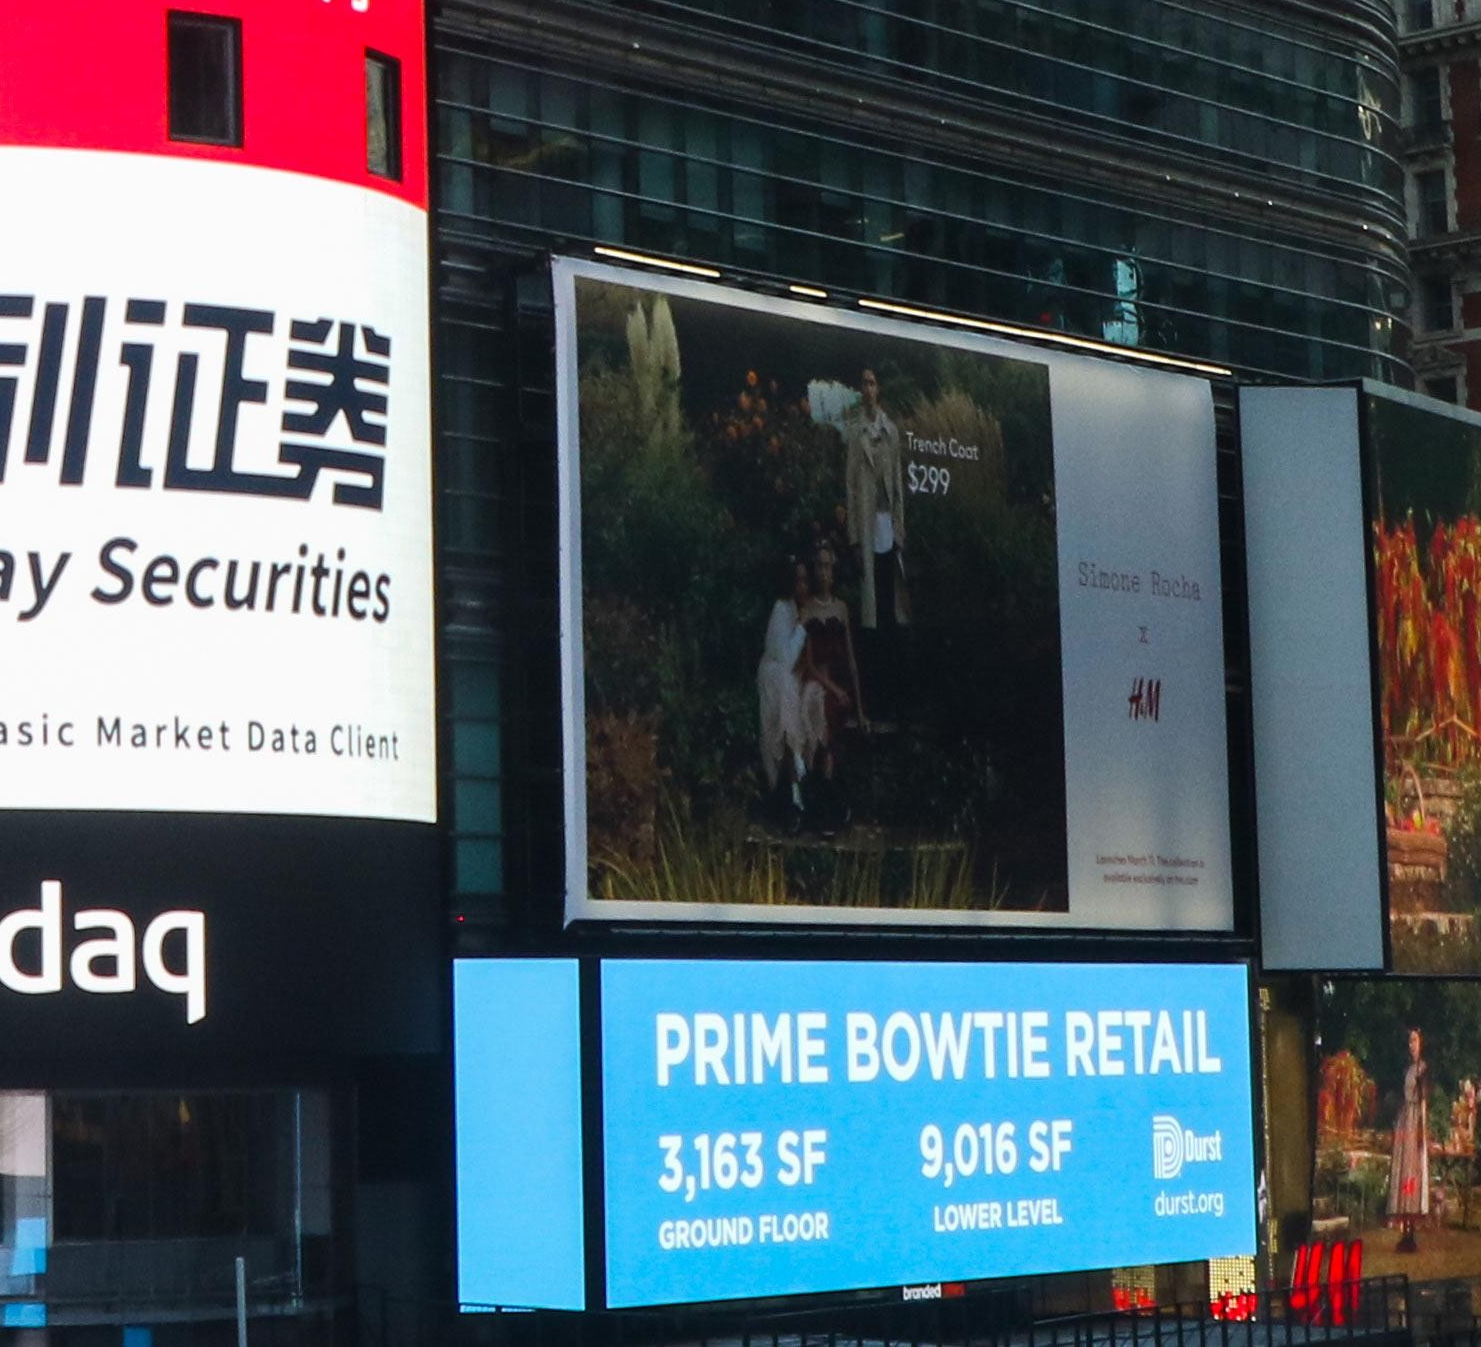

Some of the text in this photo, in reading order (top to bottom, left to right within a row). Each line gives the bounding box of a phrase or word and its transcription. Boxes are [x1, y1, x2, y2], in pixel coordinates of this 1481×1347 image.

[906, 430, 978, 461] Trench Coat
[908, 461, 950, 494] $299
[92, 537, 391, 623] Securities
[1078, 561, 1202, 601] Simone Rocha
[97, 717, 230, 751] Market
[248, 721, 317, 755] Data
[331, 724, 399, 761] Client
[655, 1009, 1222, 1087] PRIME BOWTIE RETAIL
[919, 1118, 1074, 1188] 9,016 SF
[1185, 1129, 1223, 1162] Durst
[658, 1129, 828, 1203] 3,163 SF
[933, 1198, 1064, 1232] LOWER LEVEL
[1154, 1190, 1225, 1217] durst.org
[658, 1211, 830, 1250] GROUND FLOOR
[902, 1283, 942, 1301] branded
